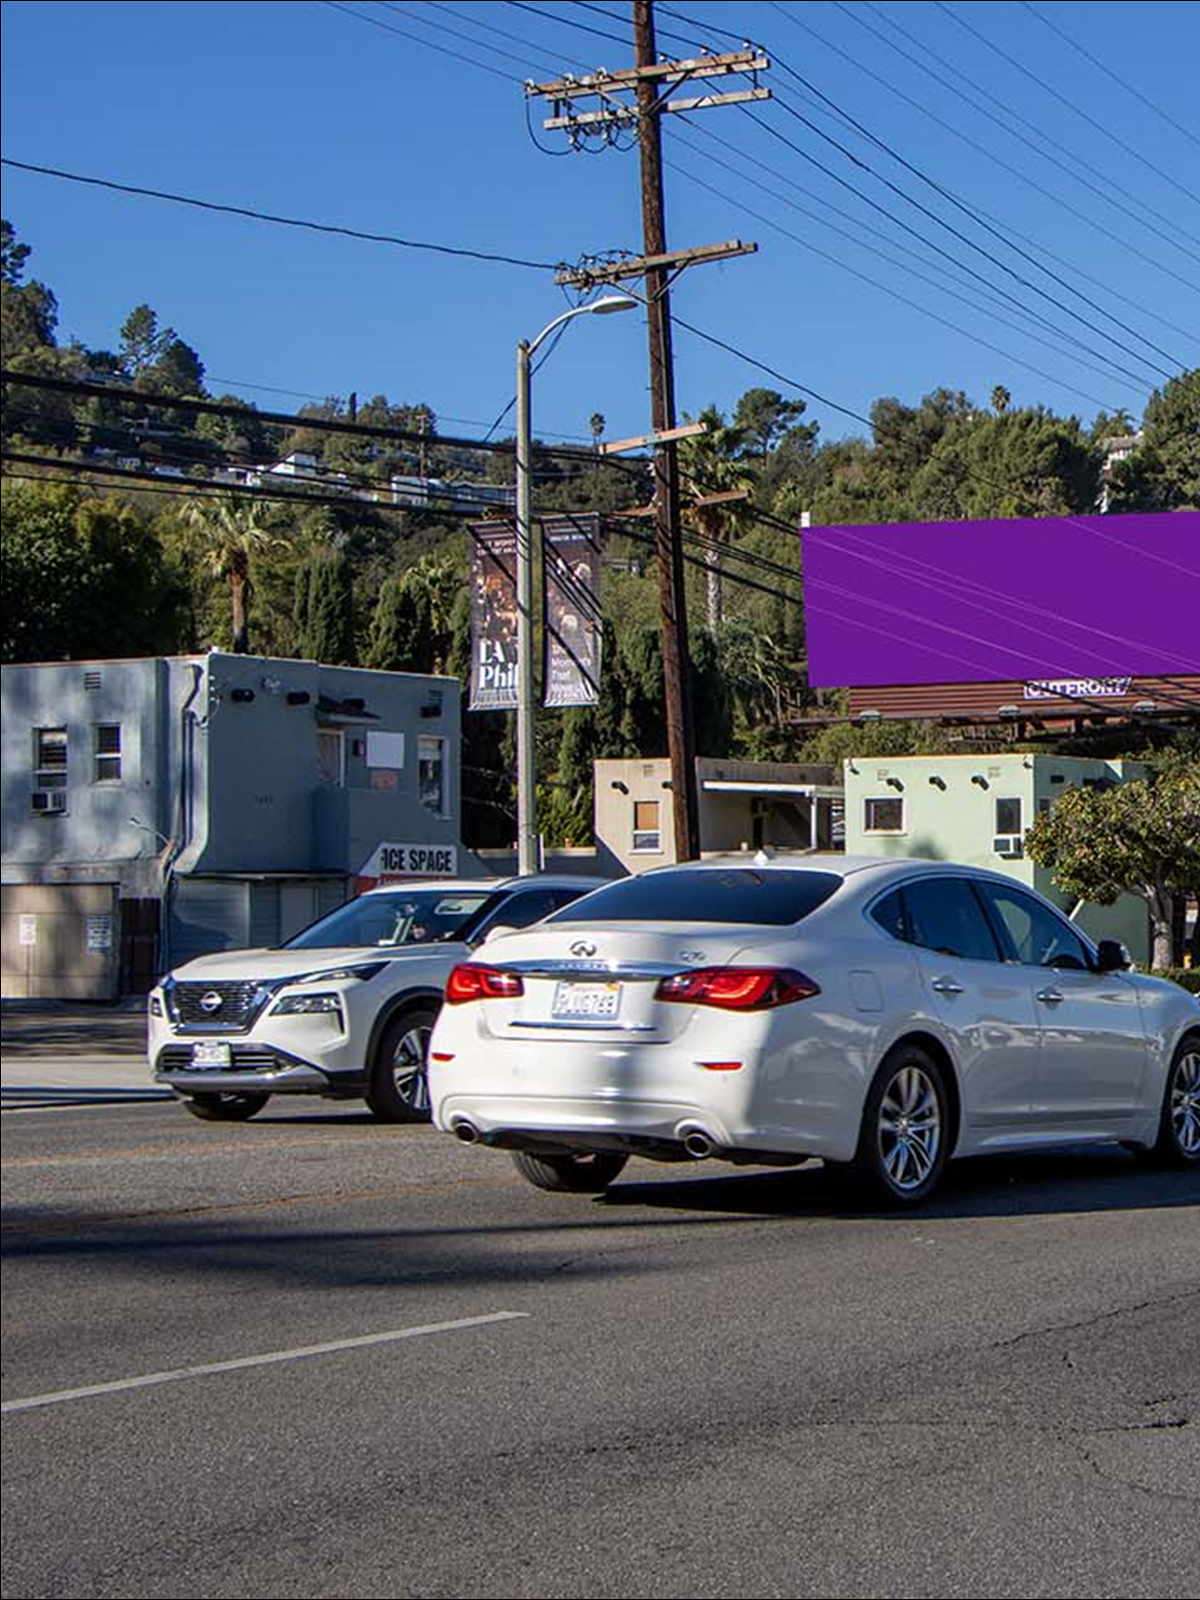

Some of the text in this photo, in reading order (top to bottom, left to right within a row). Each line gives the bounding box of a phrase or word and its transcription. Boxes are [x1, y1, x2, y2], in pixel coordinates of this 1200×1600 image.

[479, 639, 505, 663] LA
[479, 661, 519, 688] Phil
[409, 849, 452, 872] SPACE
